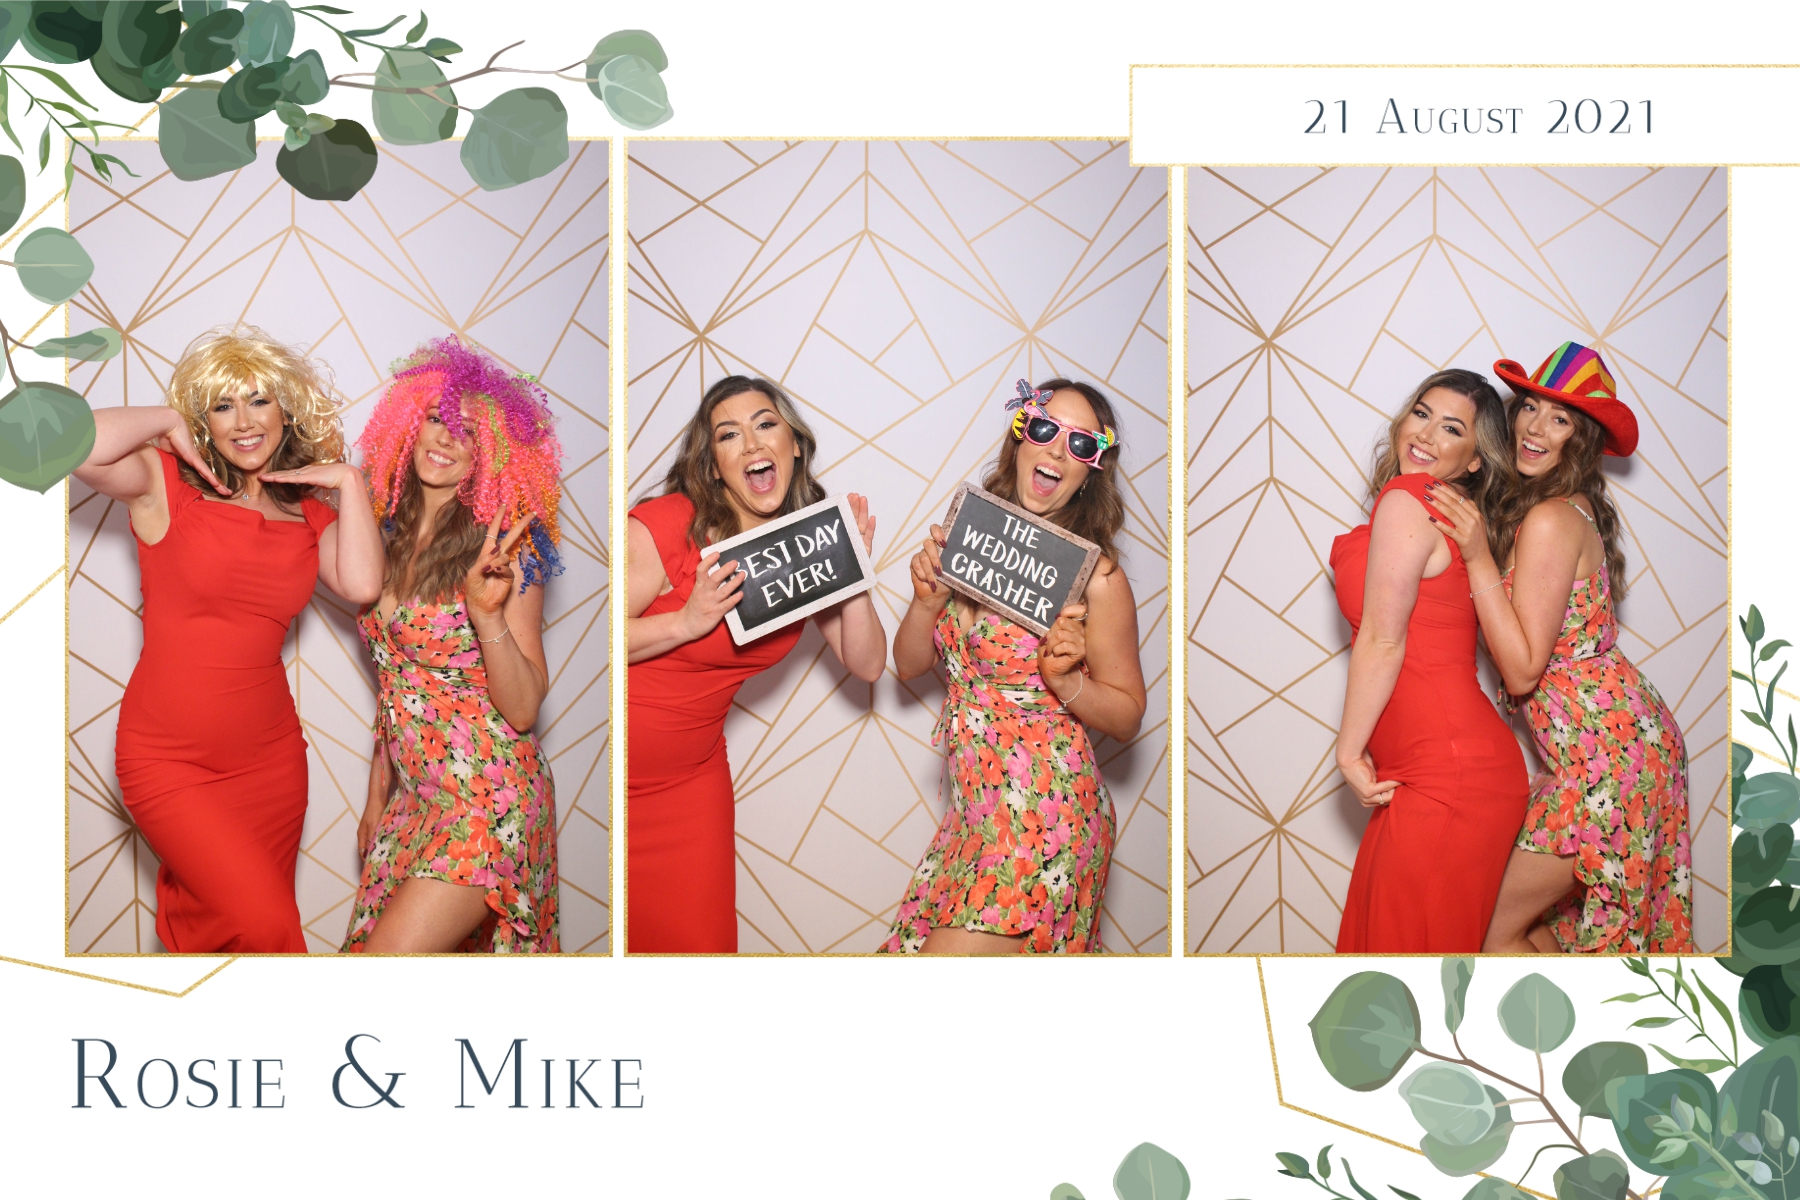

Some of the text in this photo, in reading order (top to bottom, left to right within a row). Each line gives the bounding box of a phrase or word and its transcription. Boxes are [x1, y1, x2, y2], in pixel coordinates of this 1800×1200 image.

[795, 519, 840, 558] DAY
[1003, 514, 1042, 549] THE
[962, 525, 1058, 589] WEDDING
[761, 559, 838, 608] EVER!
[951, 553, 1054, 623] CRASHER
